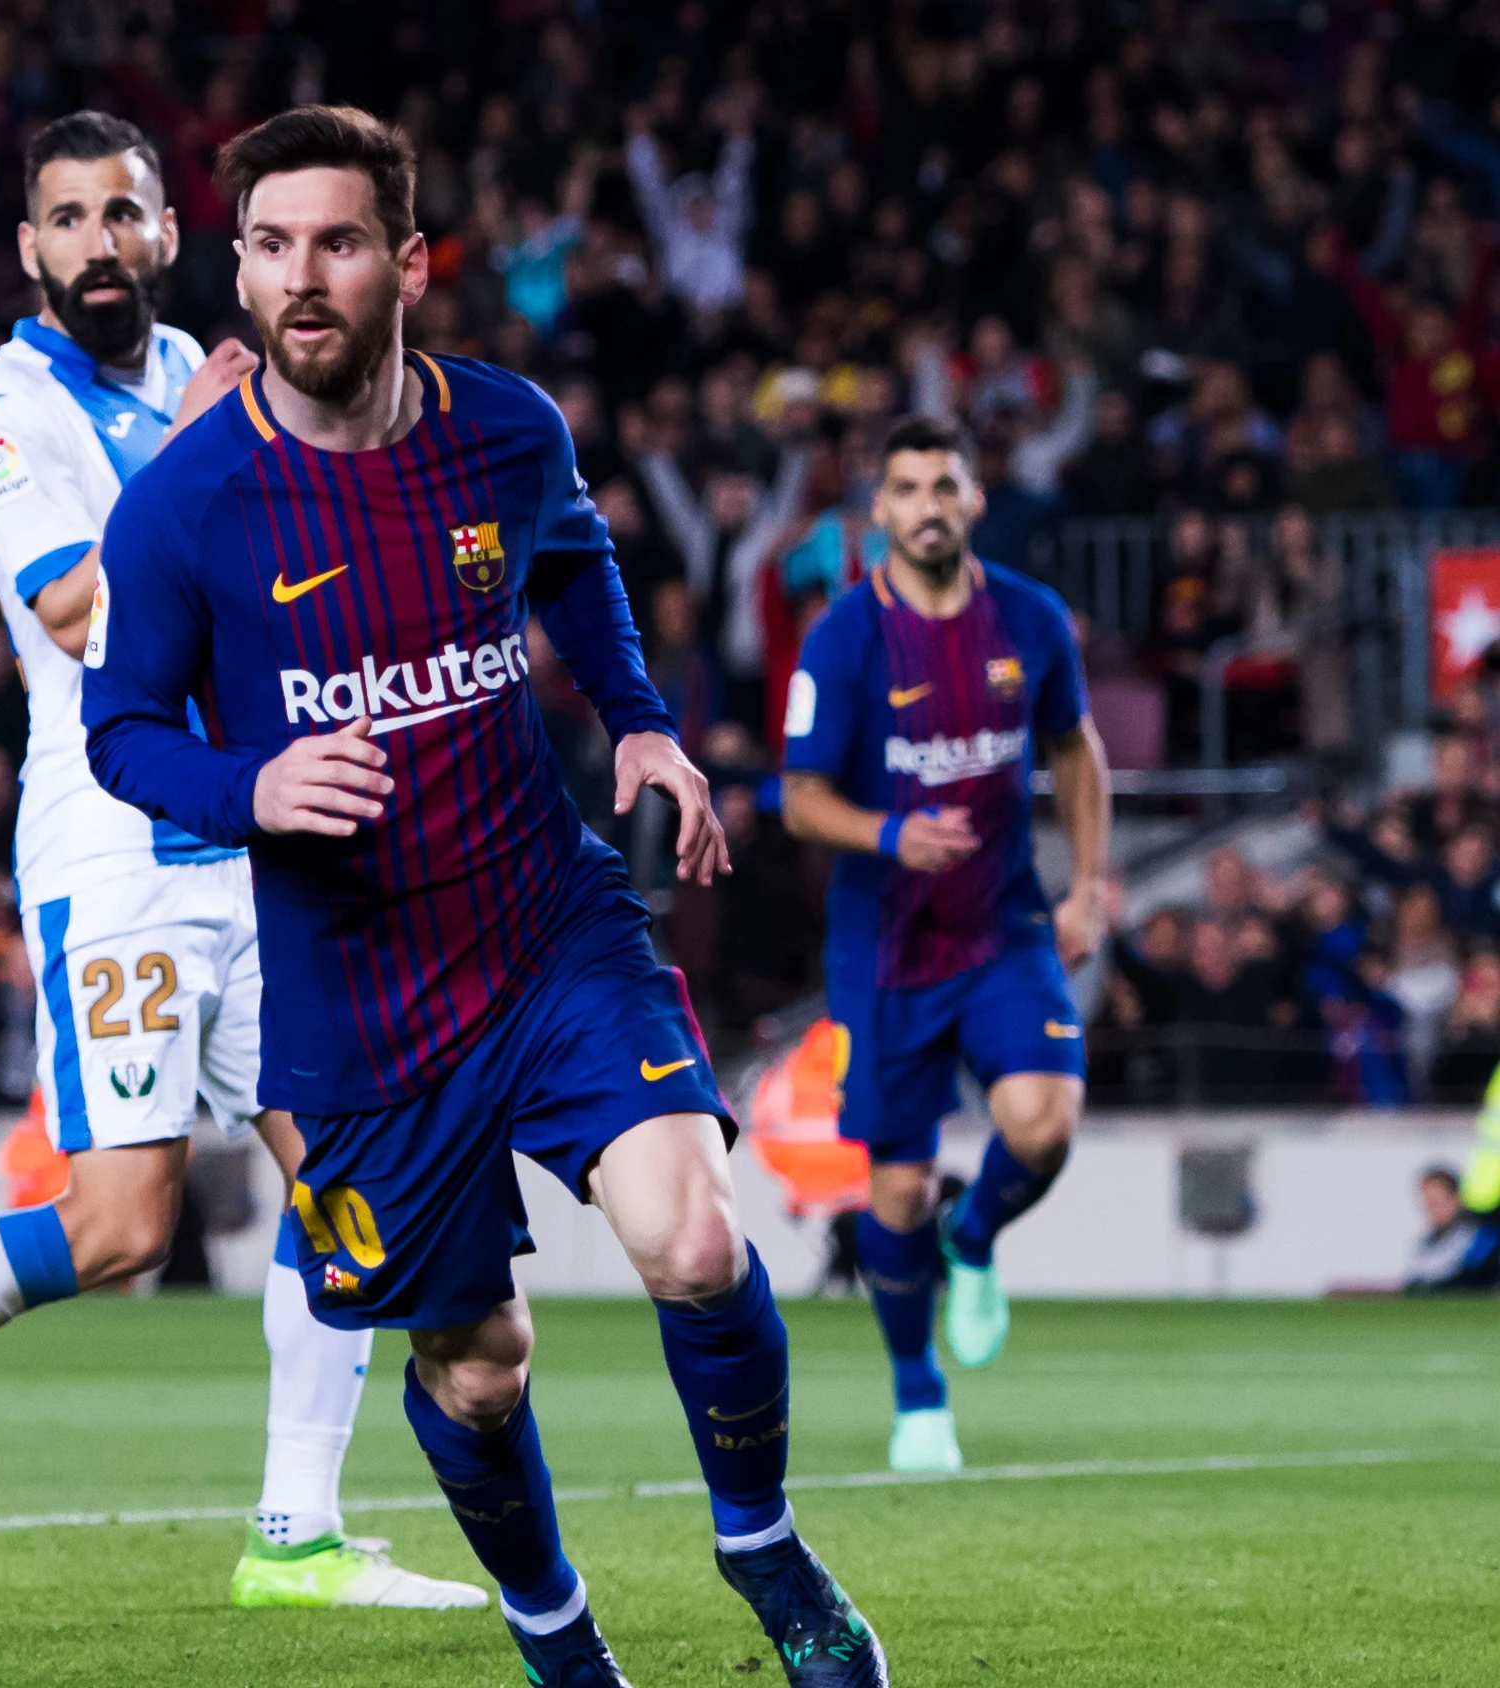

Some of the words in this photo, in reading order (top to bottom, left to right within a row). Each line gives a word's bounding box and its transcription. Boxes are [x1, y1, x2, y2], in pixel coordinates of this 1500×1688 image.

[280, 633, 529, 724] Rakuten
[82, 952, 180, 1040] 22
[291, 1180, 386, 1269] 10
